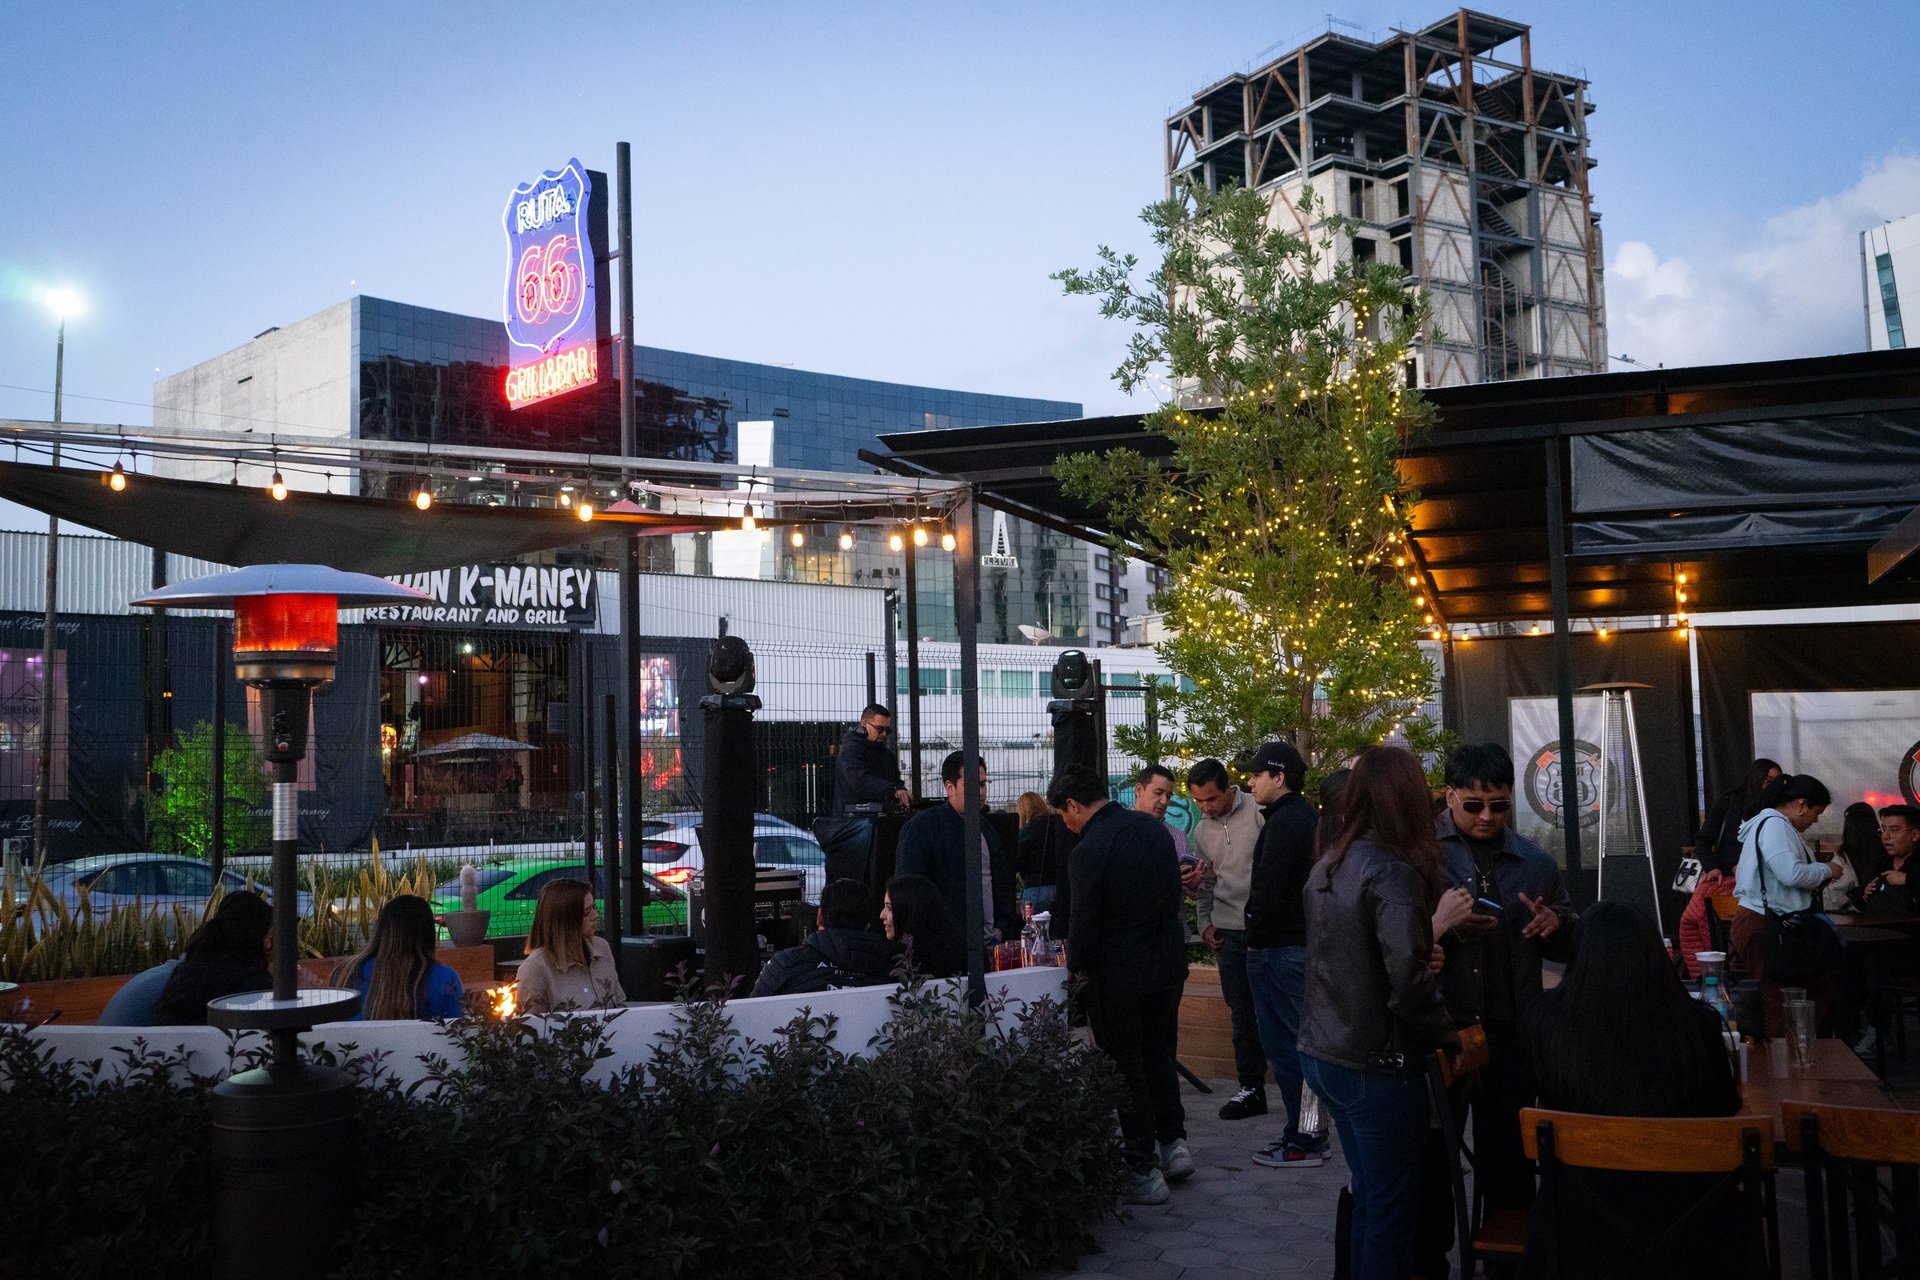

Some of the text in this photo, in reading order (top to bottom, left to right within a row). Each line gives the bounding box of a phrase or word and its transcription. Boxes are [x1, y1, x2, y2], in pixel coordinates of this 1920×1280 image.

[517, 185, 570, 234] RUTA
[516, 235, 572, 323] 66
[459, 565, 592, 609] K-MANEY
[366, 605, 568, 625] RESTAURANT AND GRILL
